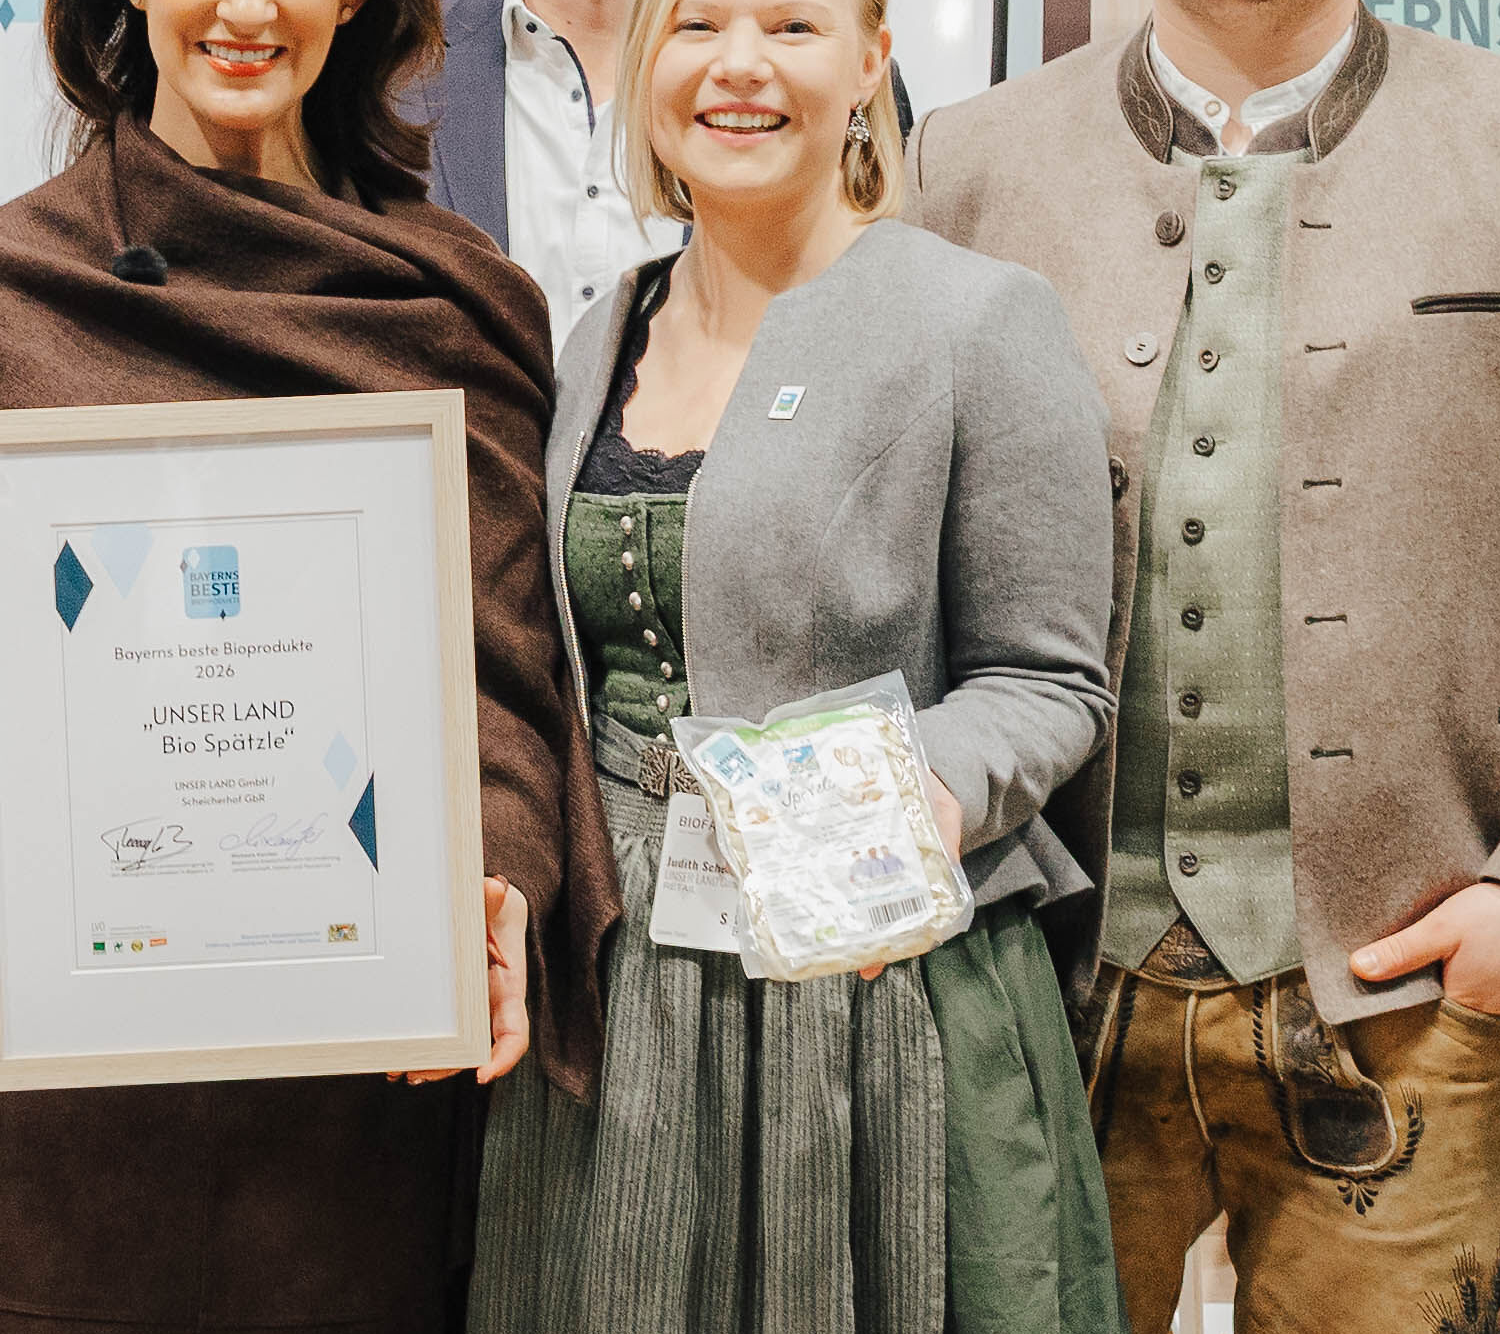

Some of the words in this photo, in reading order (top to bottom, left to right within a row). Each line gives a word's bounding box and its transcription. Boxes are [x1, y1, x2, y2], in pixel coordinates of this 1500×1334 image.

[191, 582, 239, 596] BESTE
[114, 647, 174, 662] Bayerns
[179, 644, 218, 657] beste
[224, 639, 313, 657] Bioprodukte
[196, 664, 236, 679] 2026
[144, 703, 225, 731] „UNSER
[234, 700, 295, 722] LAND
[163, 735, 197, 754] Bio
[204, 728, 294, 757] Spätzle“
[175, 780, 206, 791] UNSER
[209, 778, 236, 789] LAND
[678, 815, 716, 832] BIOFA
[667, 856, 699, 871] Judith
[702, 861, 730, 875] Sche
